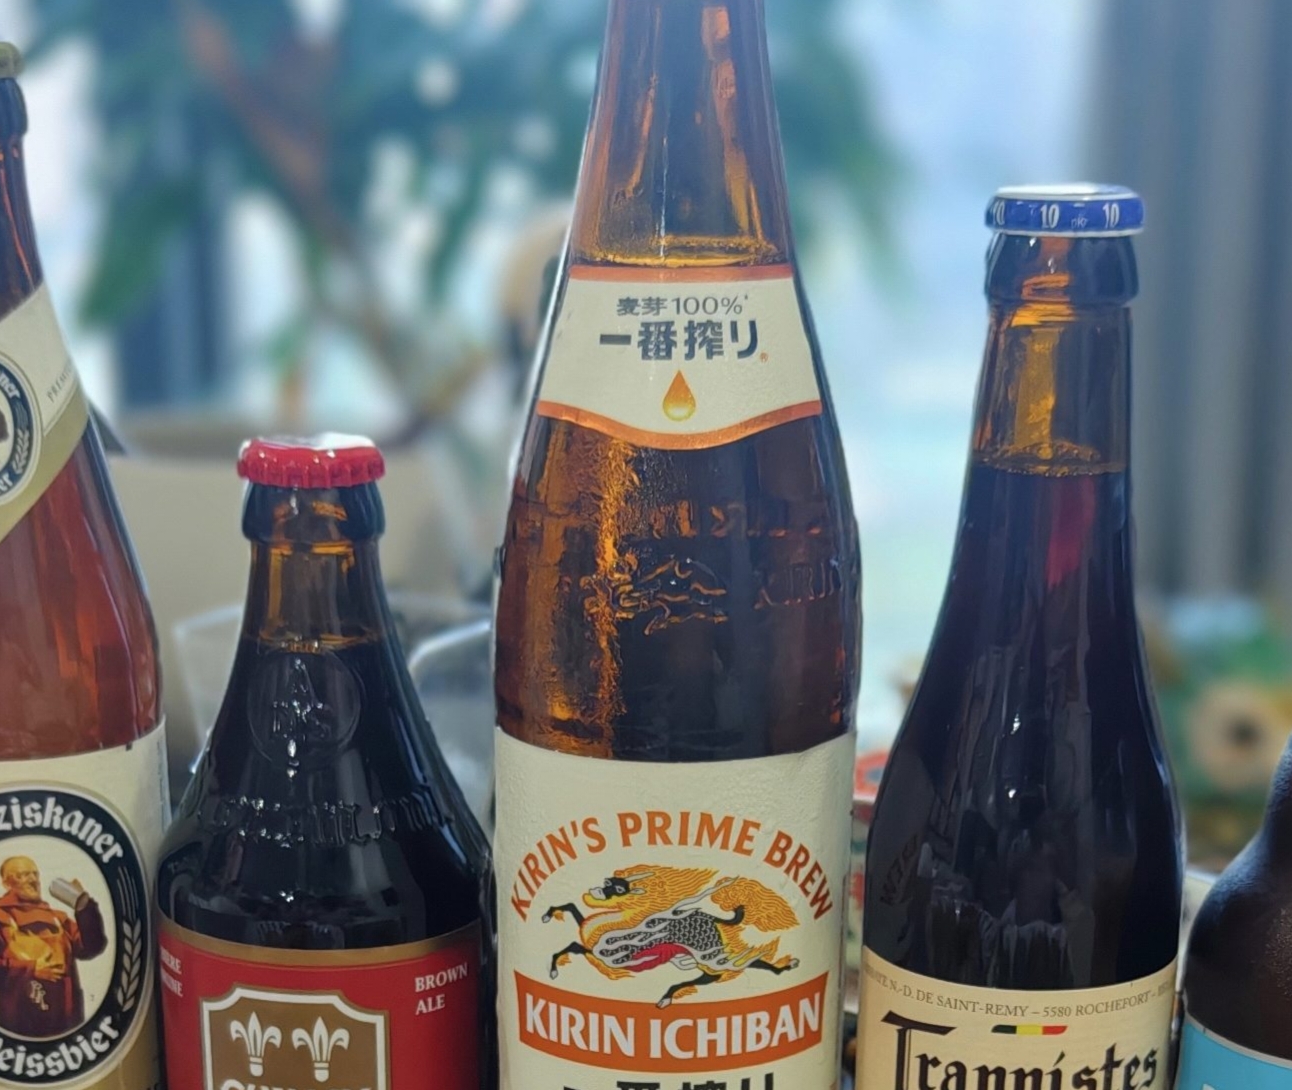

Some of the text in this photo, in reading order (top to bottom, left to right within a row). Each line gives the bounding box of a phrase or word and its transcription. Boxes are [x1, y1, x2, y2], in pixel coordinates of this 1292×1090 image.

[1040, 203, 1060, 229] 10
[1103, 202, 1120, 229] 10
[599, 319, 759, 361] 一番搾り
[511, 816, 607, 922] KIRIN'S
[617, 810, 761, 857] PRIME
[763, 830, 834, 921] BREW
[414, 961, 468, 993] BROWN
[415, 993, 446, 1016] ALE
[916, 989, 934, 1005] DE
[936, 995, 1029, 1018] SAINT-REMY
[1042, 1005, 1072, 1018] 5580
[1075, 989, 1152, 1017] ROCHEFORT
[525, 991, 821, 1059] KIRIN ICHIBAN
